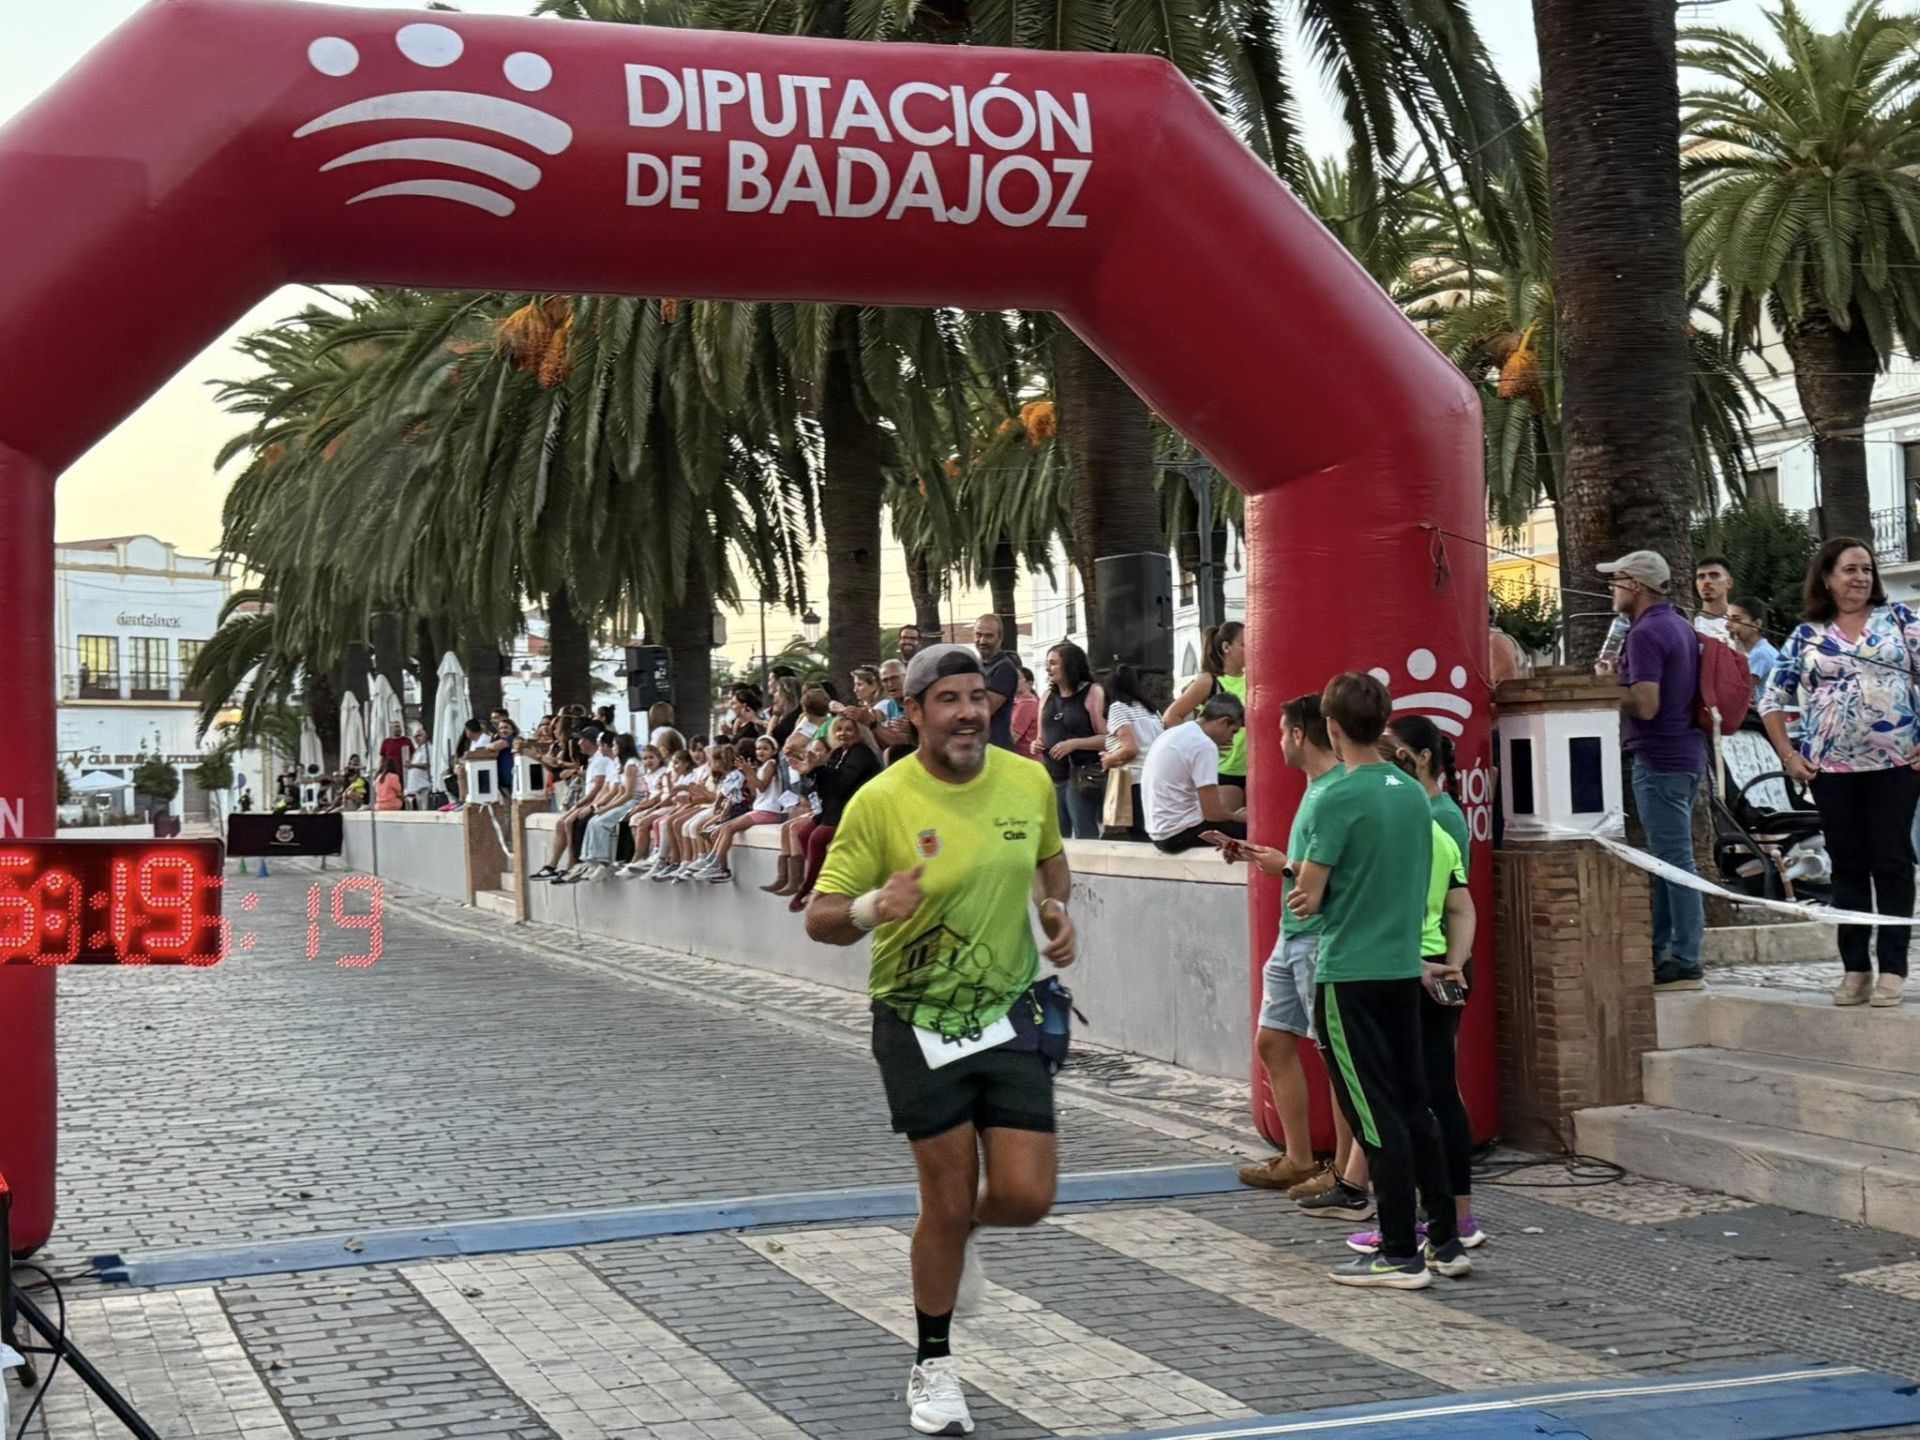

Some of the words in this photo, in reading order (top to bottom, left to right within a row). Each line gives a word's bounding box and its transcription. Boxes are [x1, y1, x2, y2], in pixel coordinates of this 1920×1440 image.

[624, 63, 1093, 153] DIPUTACIÓN
[626, 152, 701, 210] DE
[726, 140, 1093, 228] BADAJOZ
